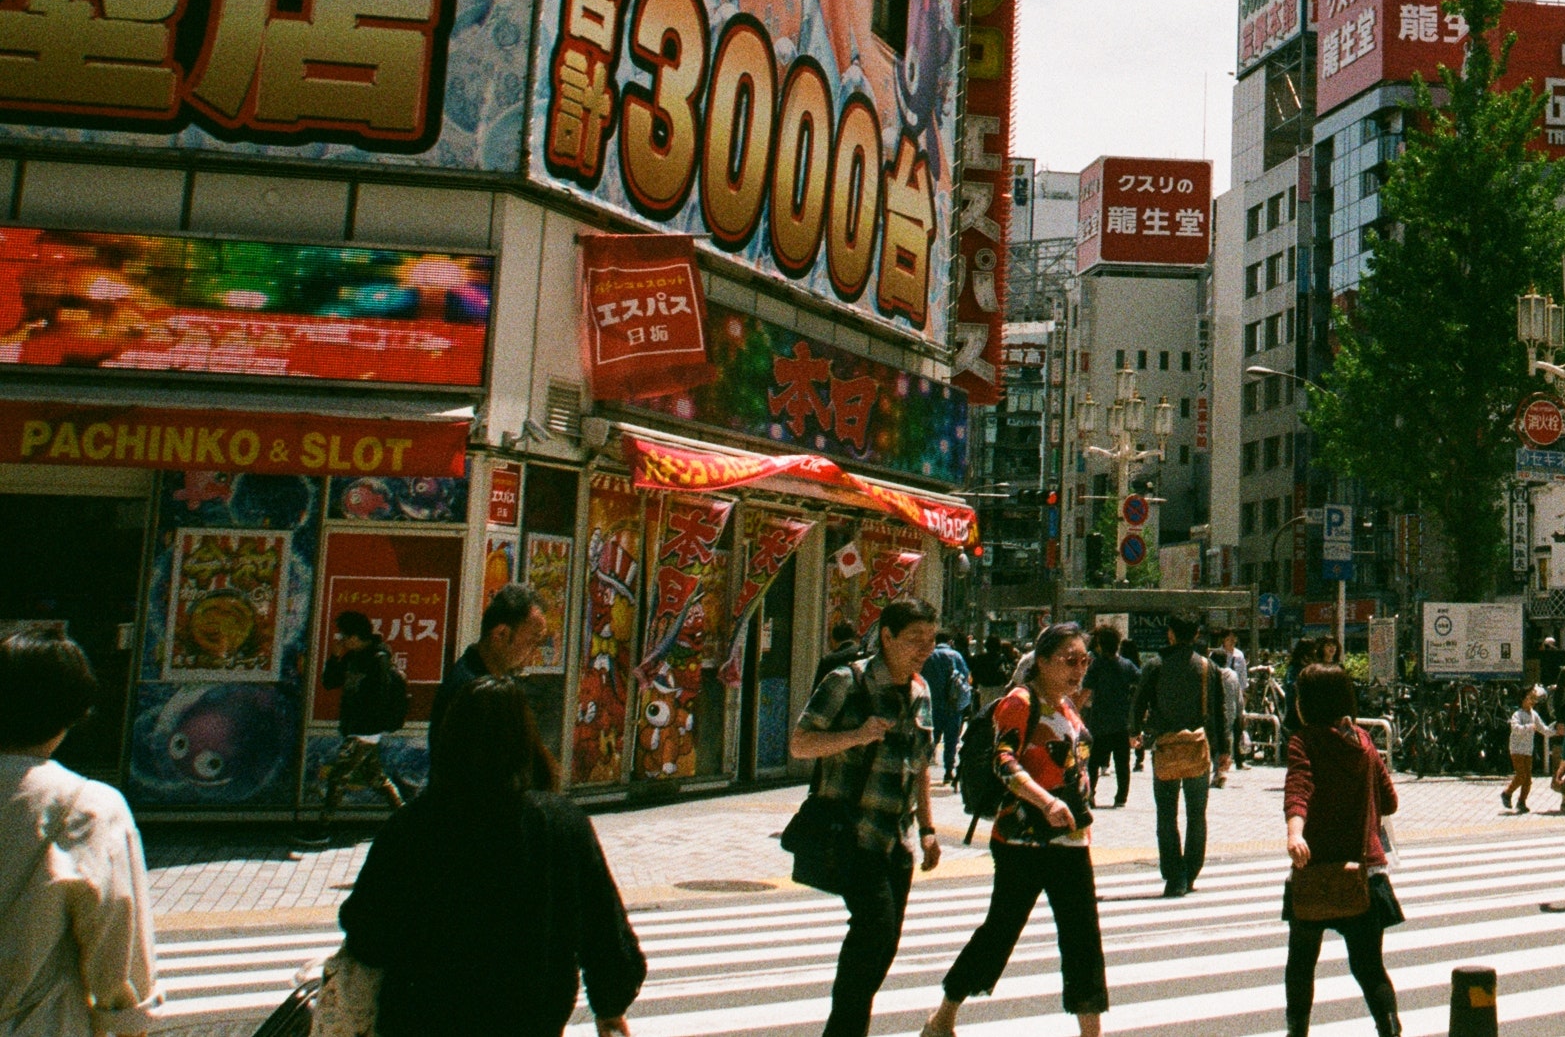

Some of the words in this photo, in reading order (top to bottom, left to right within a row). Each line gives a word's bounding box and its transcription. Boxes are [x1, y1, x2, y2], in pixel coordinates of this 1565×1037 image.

[1118, 174, 1194, 195] クスリの
[1106, 206, 1204, 238] 龍生堂
[597, 291, 692, 327] エスパス
[20, 420, 259, 466] PACHINKO
[270, 439, 288, 463] &
[302, 432, 412, 471] SLOT
[1326, 508, 1343, 536] P
